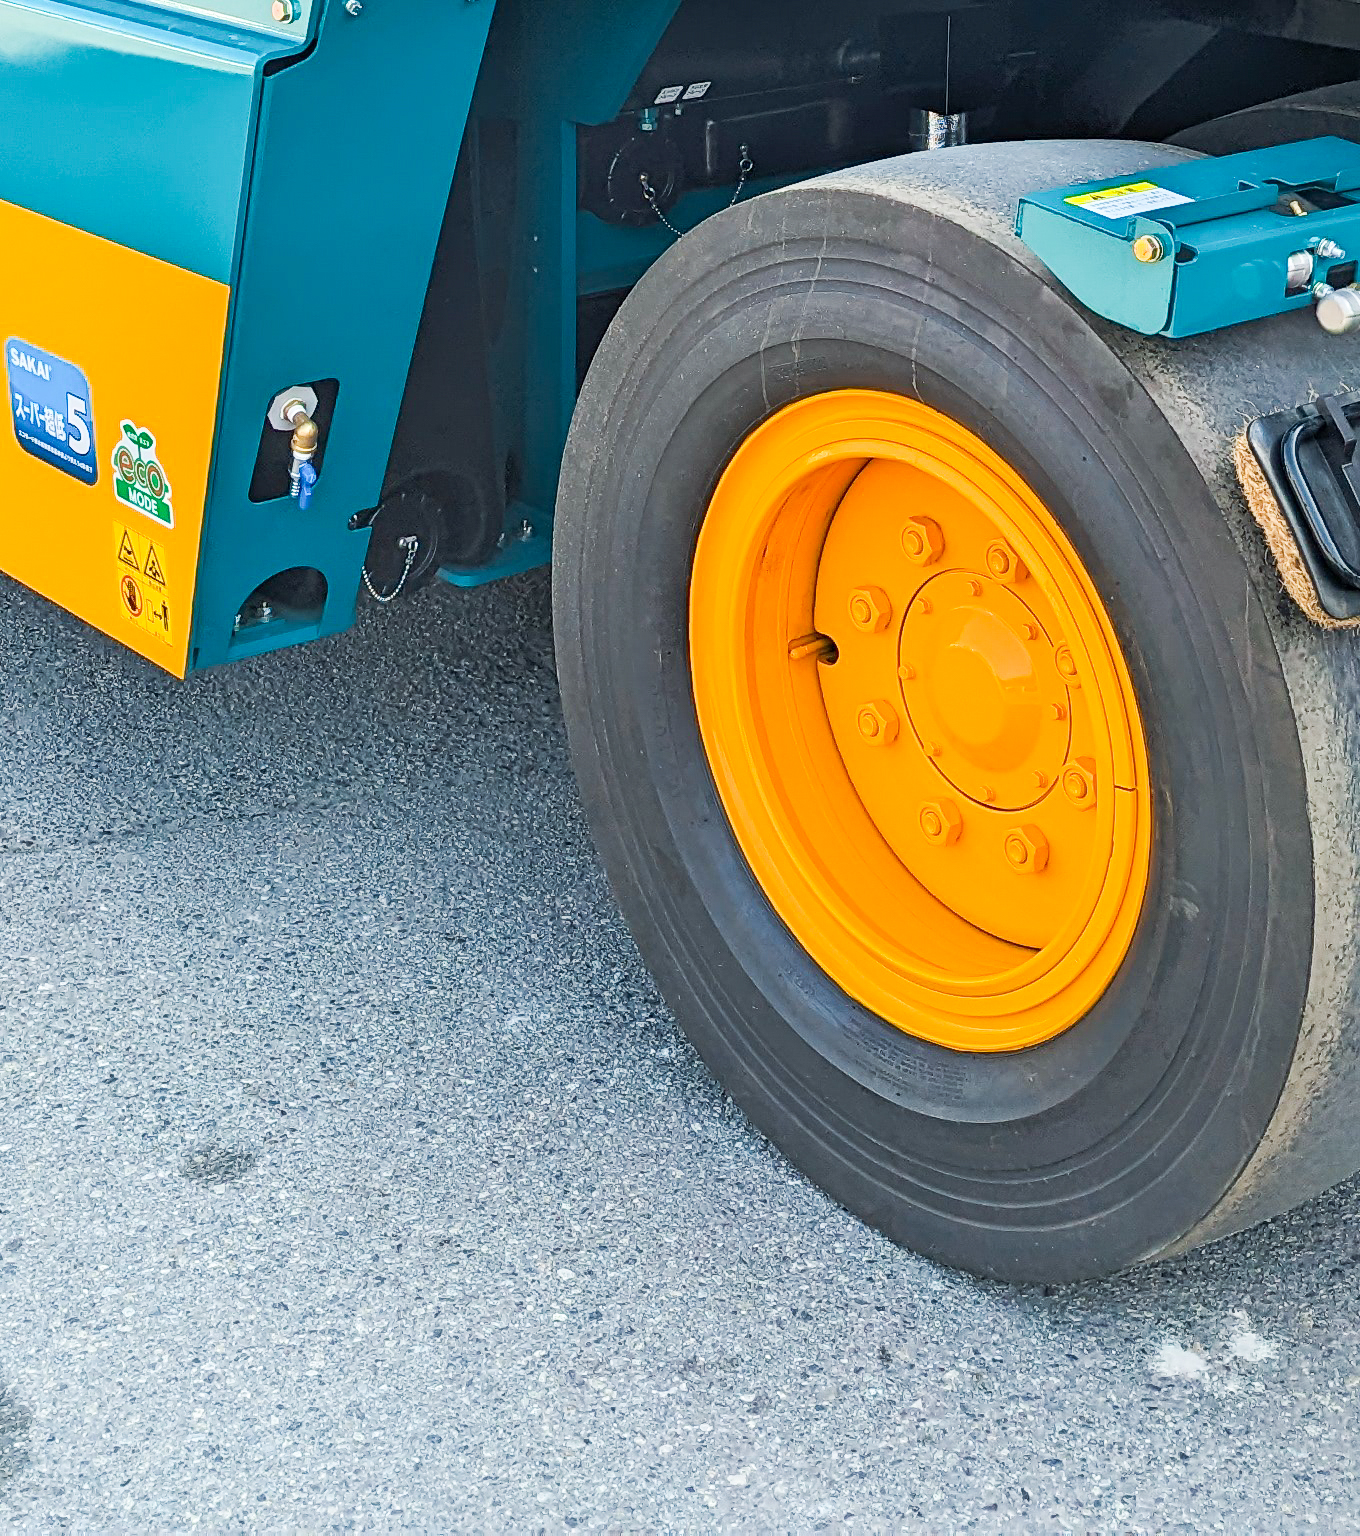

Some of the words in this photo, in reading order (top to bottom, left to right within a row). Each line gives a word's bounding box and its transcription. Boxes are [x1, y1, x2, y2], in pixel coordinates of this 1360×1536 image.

[10, 347, 51, 381] SAKAI
[66, 391, 91, 456] 5
[117, 446, 166, 500] eco
[127, 486, 159, 515] MODE
